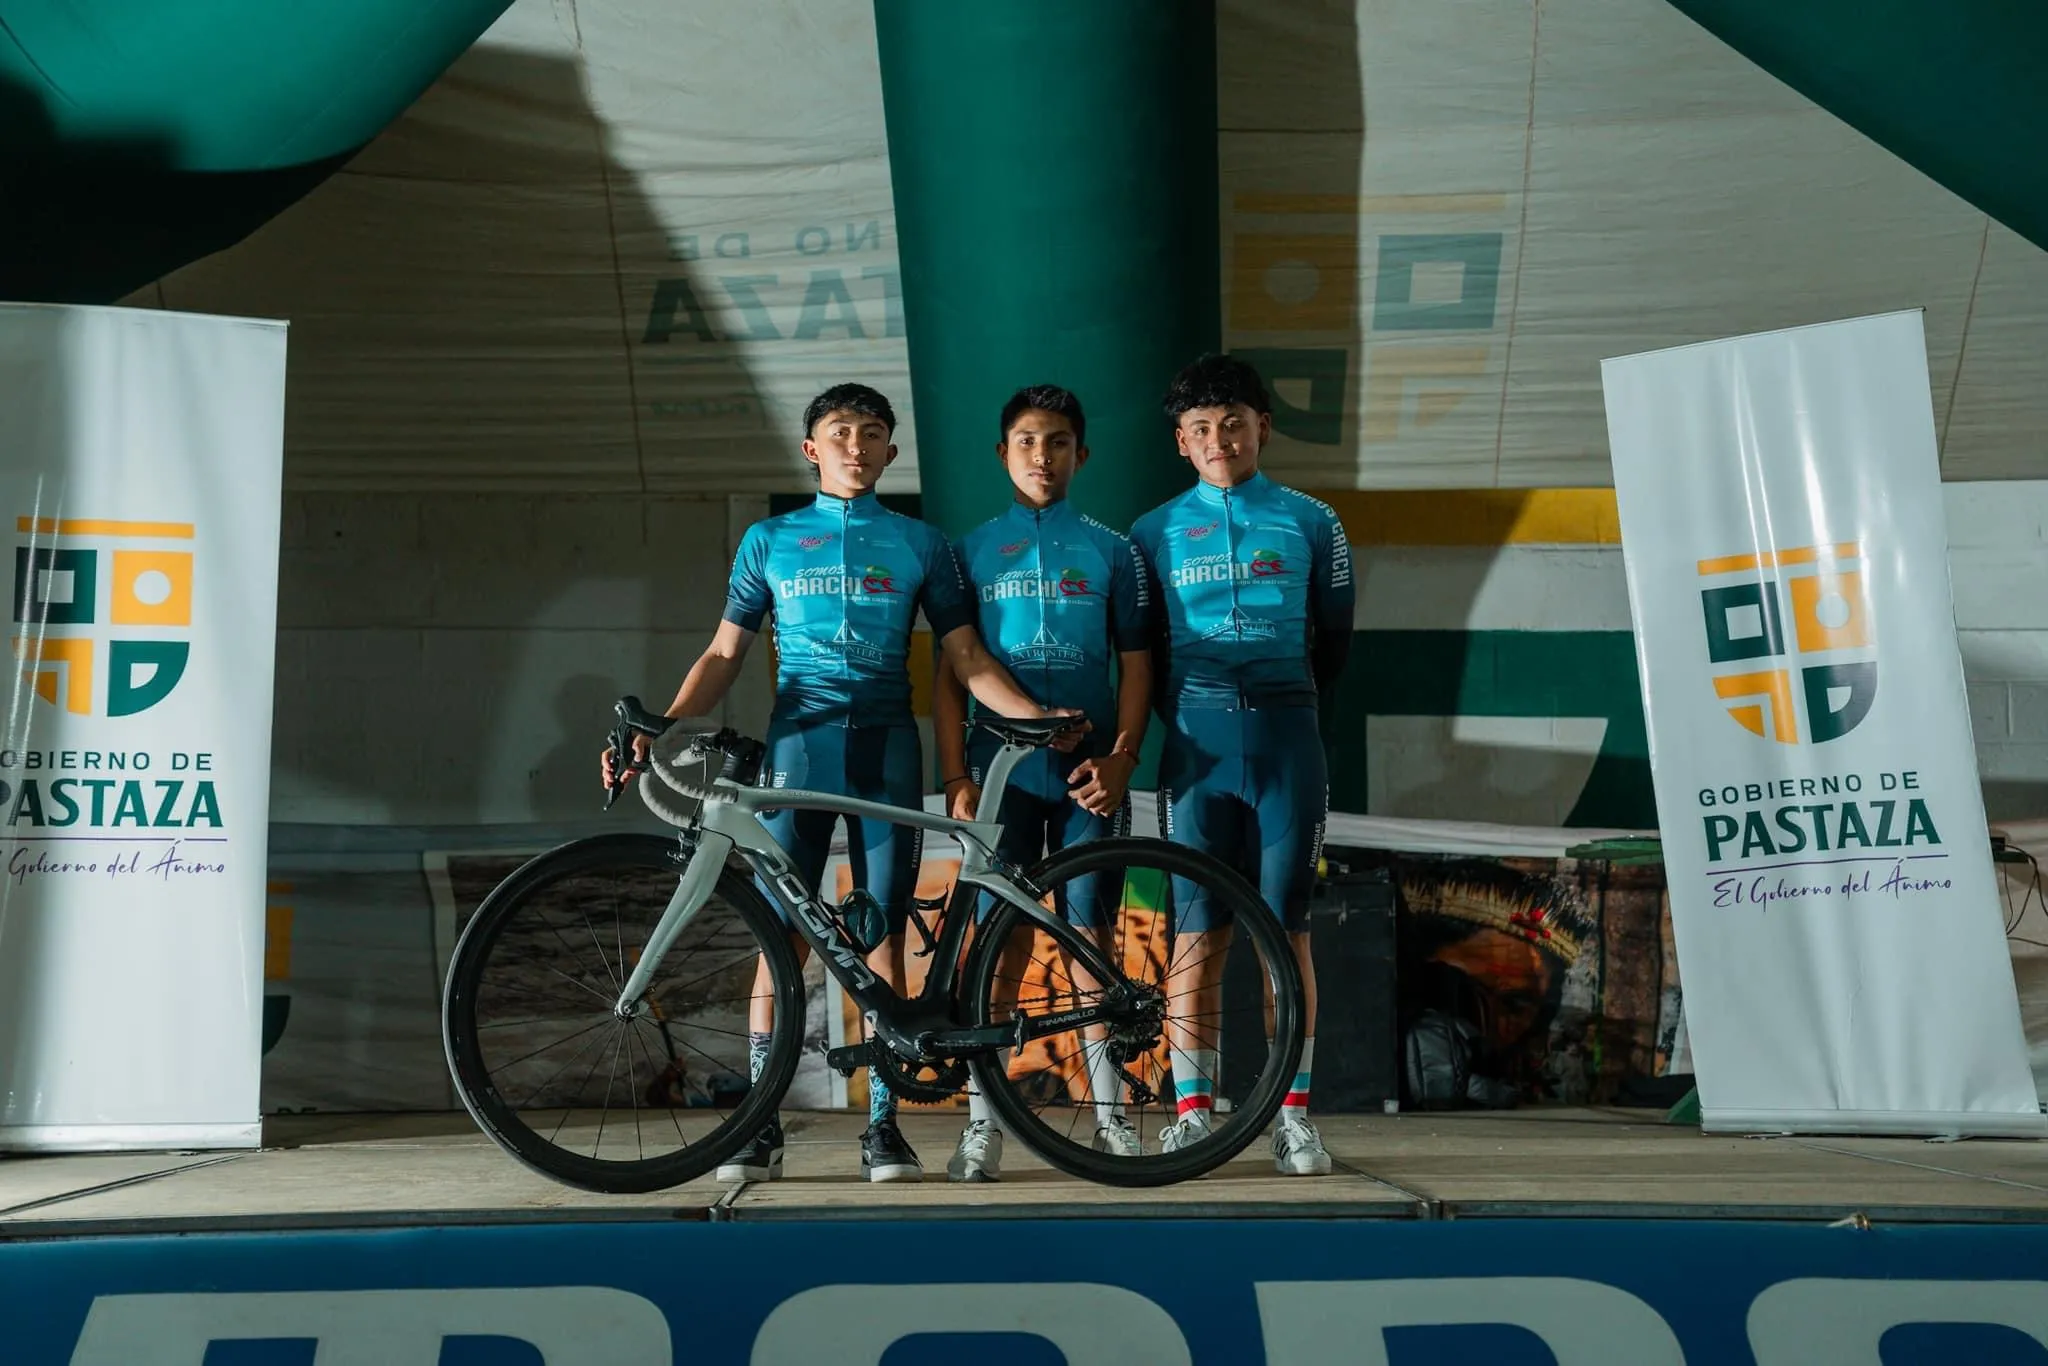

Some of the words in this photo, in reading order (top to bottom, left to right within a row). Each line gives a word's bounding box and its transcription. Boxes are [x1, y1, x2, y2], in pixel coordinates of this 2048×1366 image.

[1183, 552, 1233, 568] SOMOS
[1331, 521, 1350, 588] CARCHI
[795, 565, 847, 578] SOMOS
[995, 568, 1043, 582] SOMOS
[1169, 562, 1250, 588] CARCHI
[781, 576, 861, 599] CARCHI
[983, 580, 1057, 603] CARCHI
[171, 753, 213, 771] DE
[1699, 774, 1862, 807] GOBIERNO
[1880, 771, 1920, 791] DE
[1703, 799, 1942, 862] PASTAZA
[106, 852, 140, 879] del
[144, 840, 225, 881] Ánimo
[1713, 878, 1743, 908] El
[1750, 876, 1832, 912] Gobierno
[1841, 870, 1870, 900] del
[1878, 858, 1952, 899] Ánimo
[762, 847, 877, 991] DOGMA
[1036, 1009, 1097, 1028] PINARELLO
